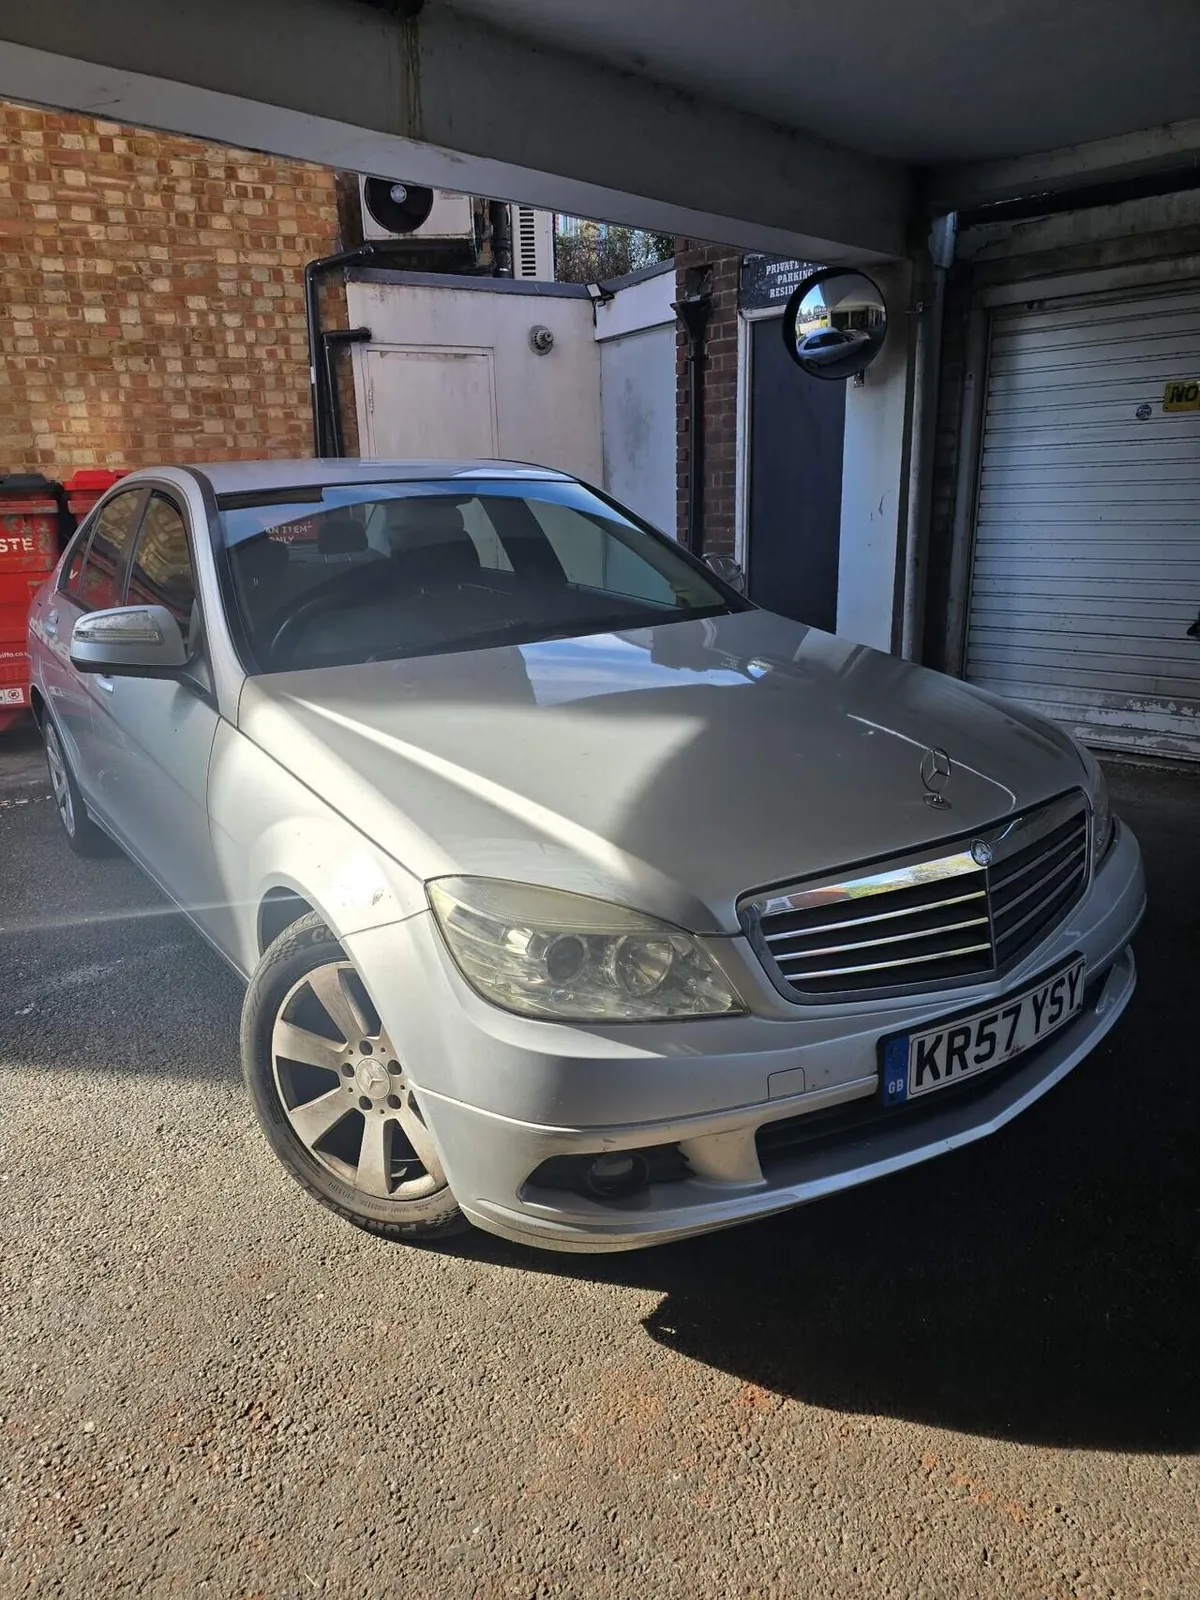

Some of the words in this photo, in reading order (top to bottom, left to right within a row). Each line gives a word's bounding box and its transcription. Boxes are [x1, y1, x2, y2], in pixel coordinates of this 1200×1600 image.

[766, 260, 800, 275] PRIVATE
[777, 268, 814, 285] PARKING
[1169, 385, 1199, 403] NO
[0, 537, 34, 553] STE
[915, 1003, 1022, 1087] KR57
[1032, 963, 1084, 1035] YSY
[888, 1079, 904, 1094] GB
